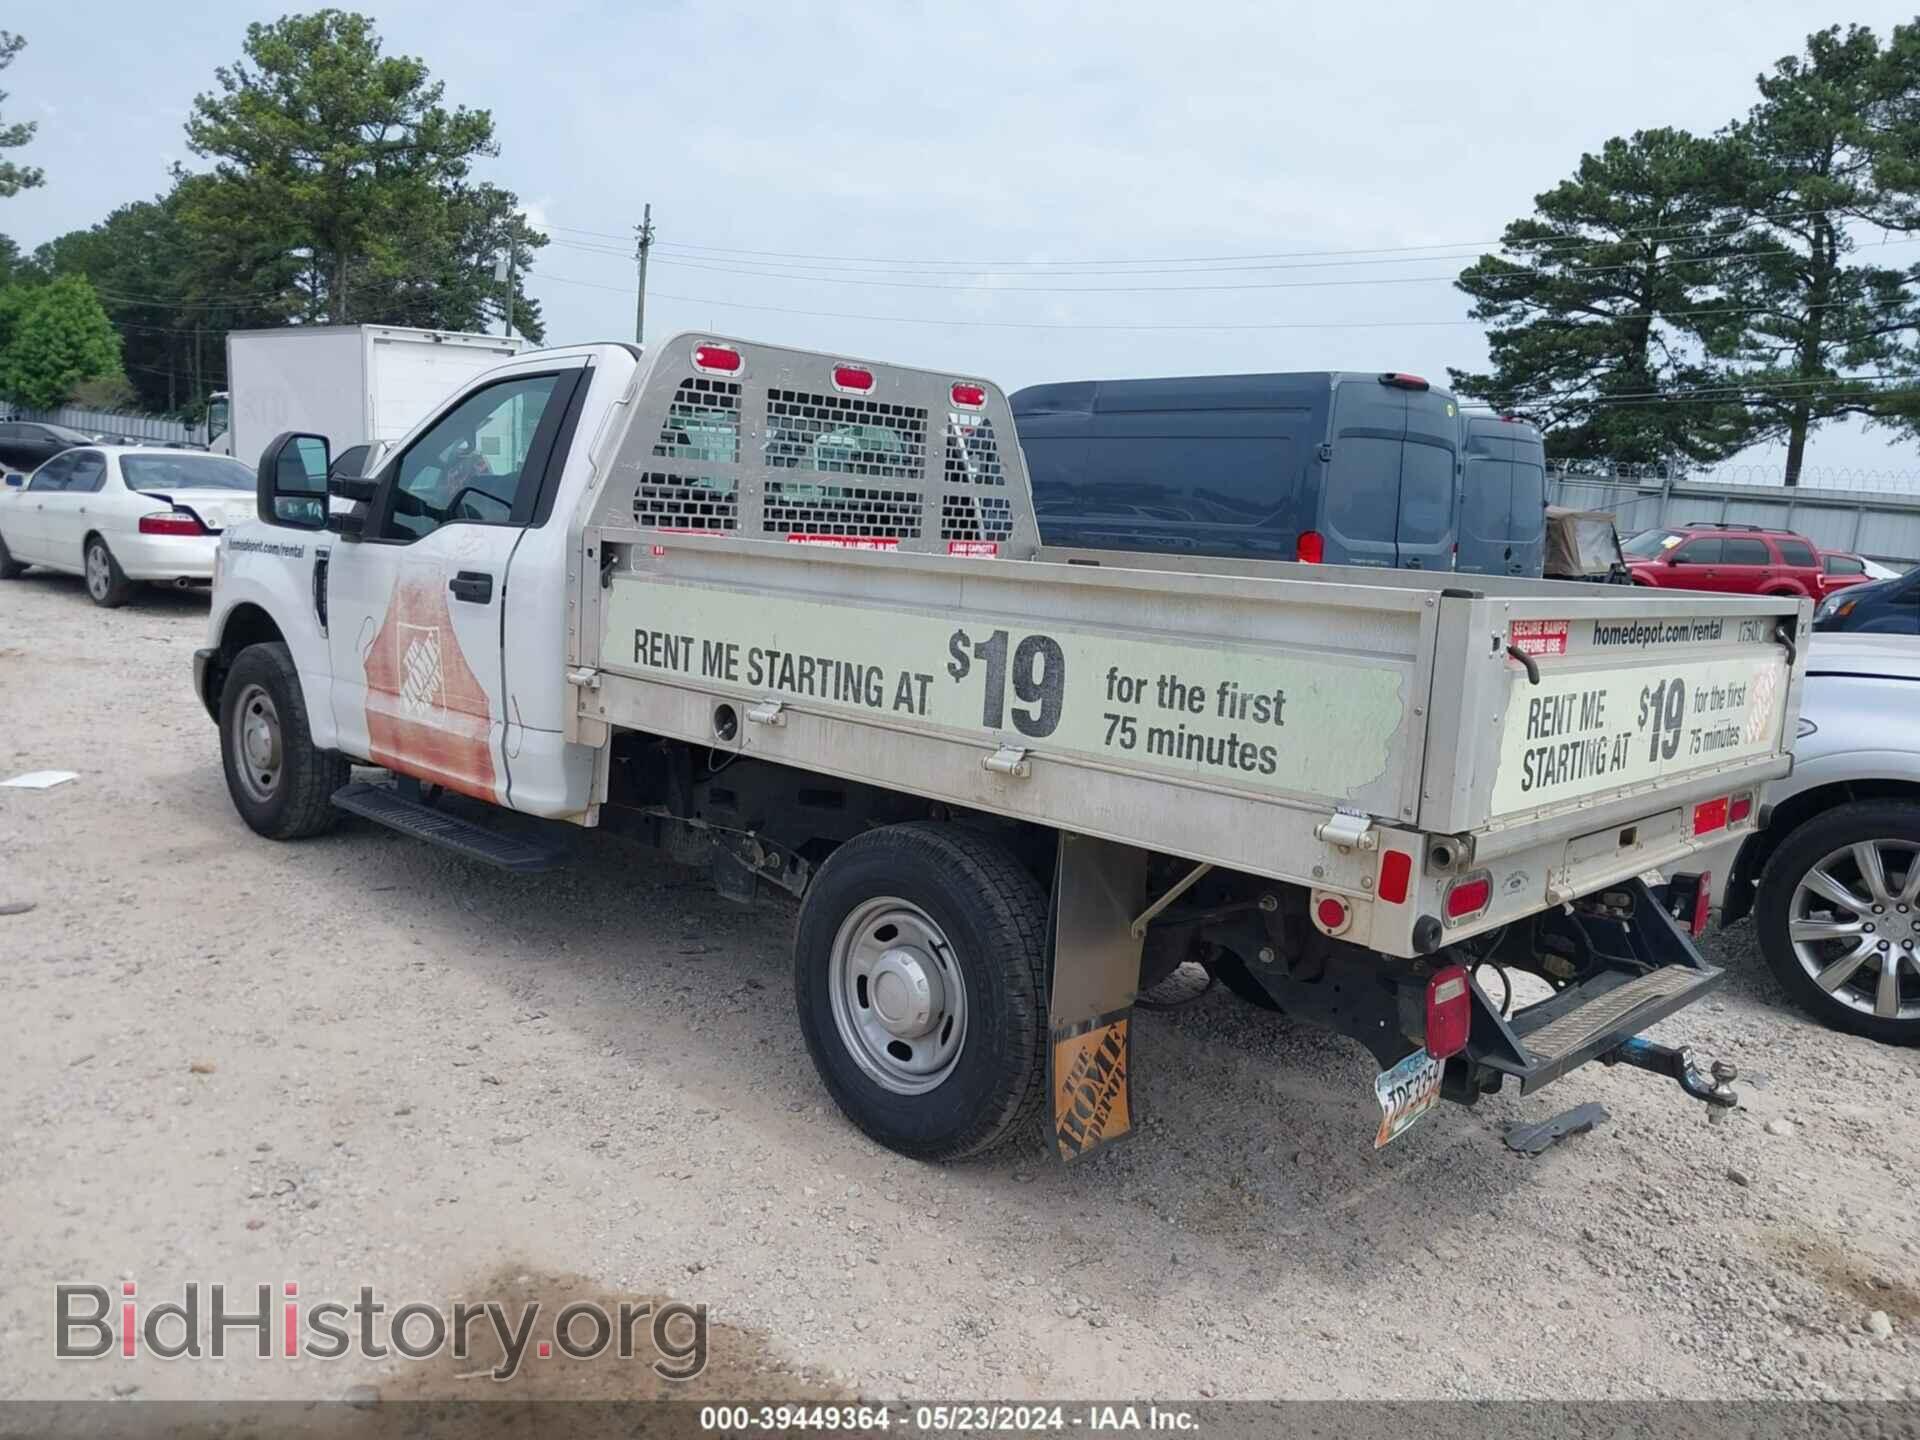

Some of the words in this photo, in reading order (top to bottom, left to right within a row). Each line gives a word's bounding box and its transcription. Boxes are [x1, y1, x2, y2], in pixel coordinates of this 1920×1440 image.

[1593, 618, 1723, 648] homedepot.com/rental
[634, 629, 694, 672] RENT
[702, 640, 739, 681] ME
[747, 647, 884, 708] STARTING
[893, 671, 933, 716] AT
[947, 629, 1065, 738] $19
[1106, 667, 1148, 704] for
[1156, 675, 1205, 713] the
[1216, 681, 1286, 726] first
[1694, 687, 1708, 713] for
[1710, 683, 1726, 709] the
[1728, 681, 1747, 708] first
[1103, 713, 1137, 749] 75
[1147, 724, 1277, 774] minutes
[1527, 693, 1577, 740] RENT
[1579, 689, 1607, 731] ME
[1638, 678, 1685, 763] $19
[1689, 729, 1701, 756] 75
[1703, 723, 1740, 753] minutes
[1521, 734, 1608, 792] STARTING
[1610, 732, 1632, 772] AT
